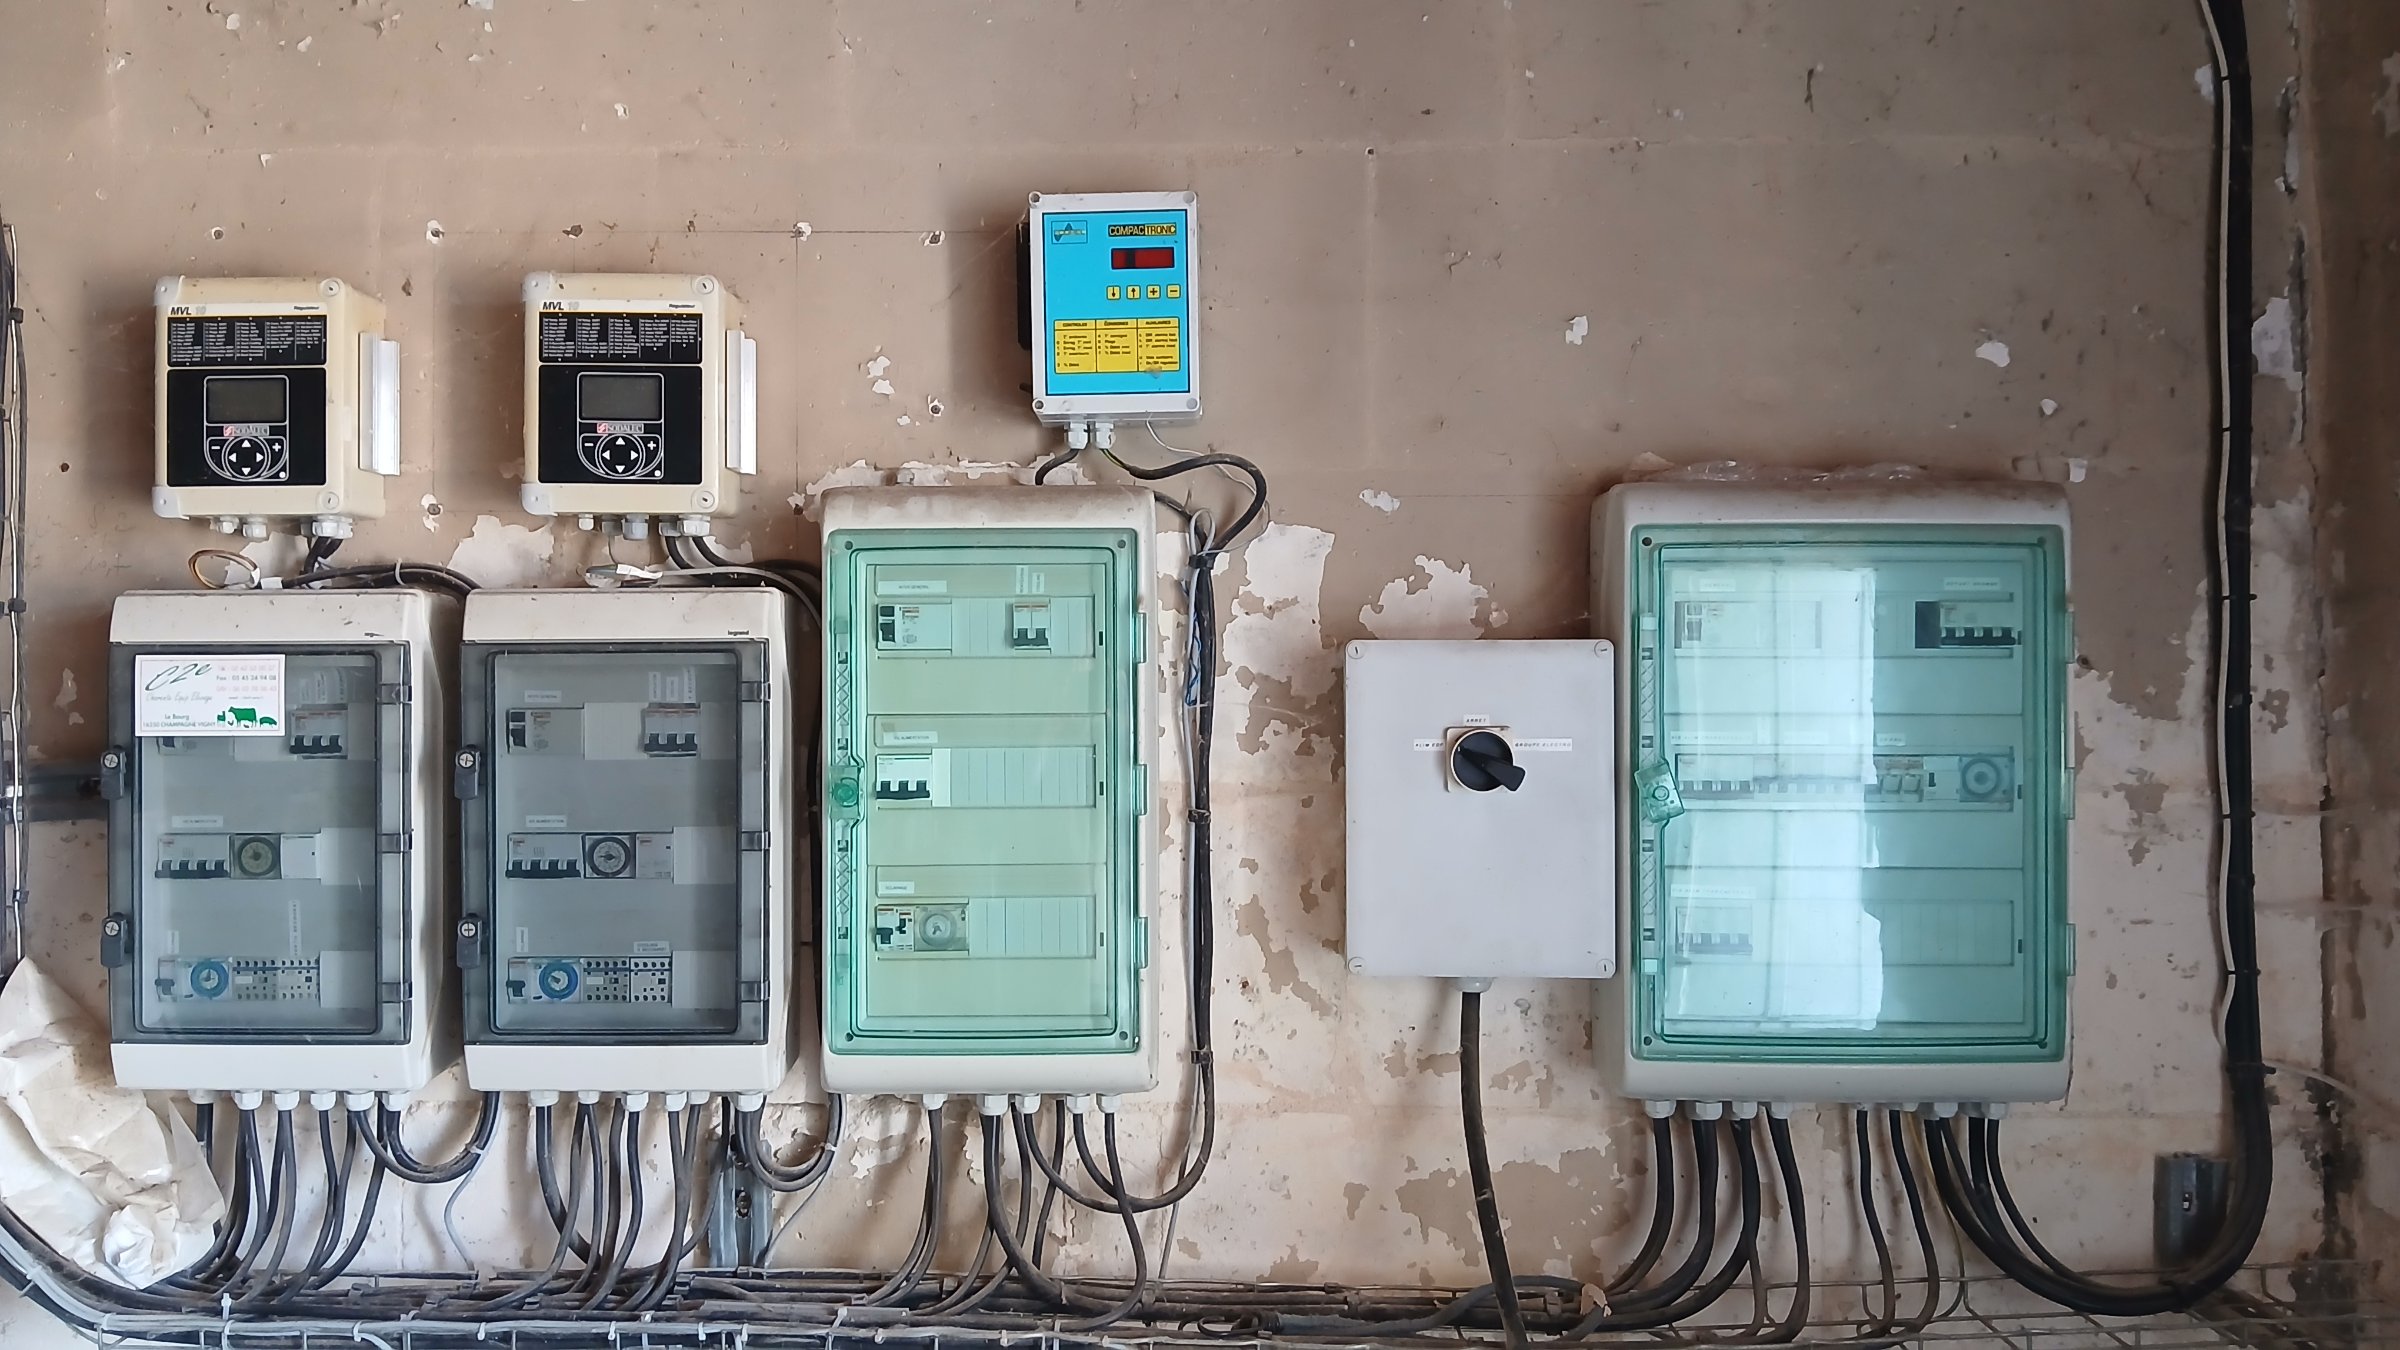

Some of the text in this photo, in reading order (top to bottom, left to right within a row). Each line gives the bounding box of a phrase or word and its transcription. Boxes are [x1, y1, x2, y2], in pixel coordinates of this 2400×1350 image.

[1109, 224, 1175, 236] COMPACTRONIC
[543, 302, 564, 311] MVL
[170, 307, 191, 315] MVL
[172, 713, 190, 721] Bourg
